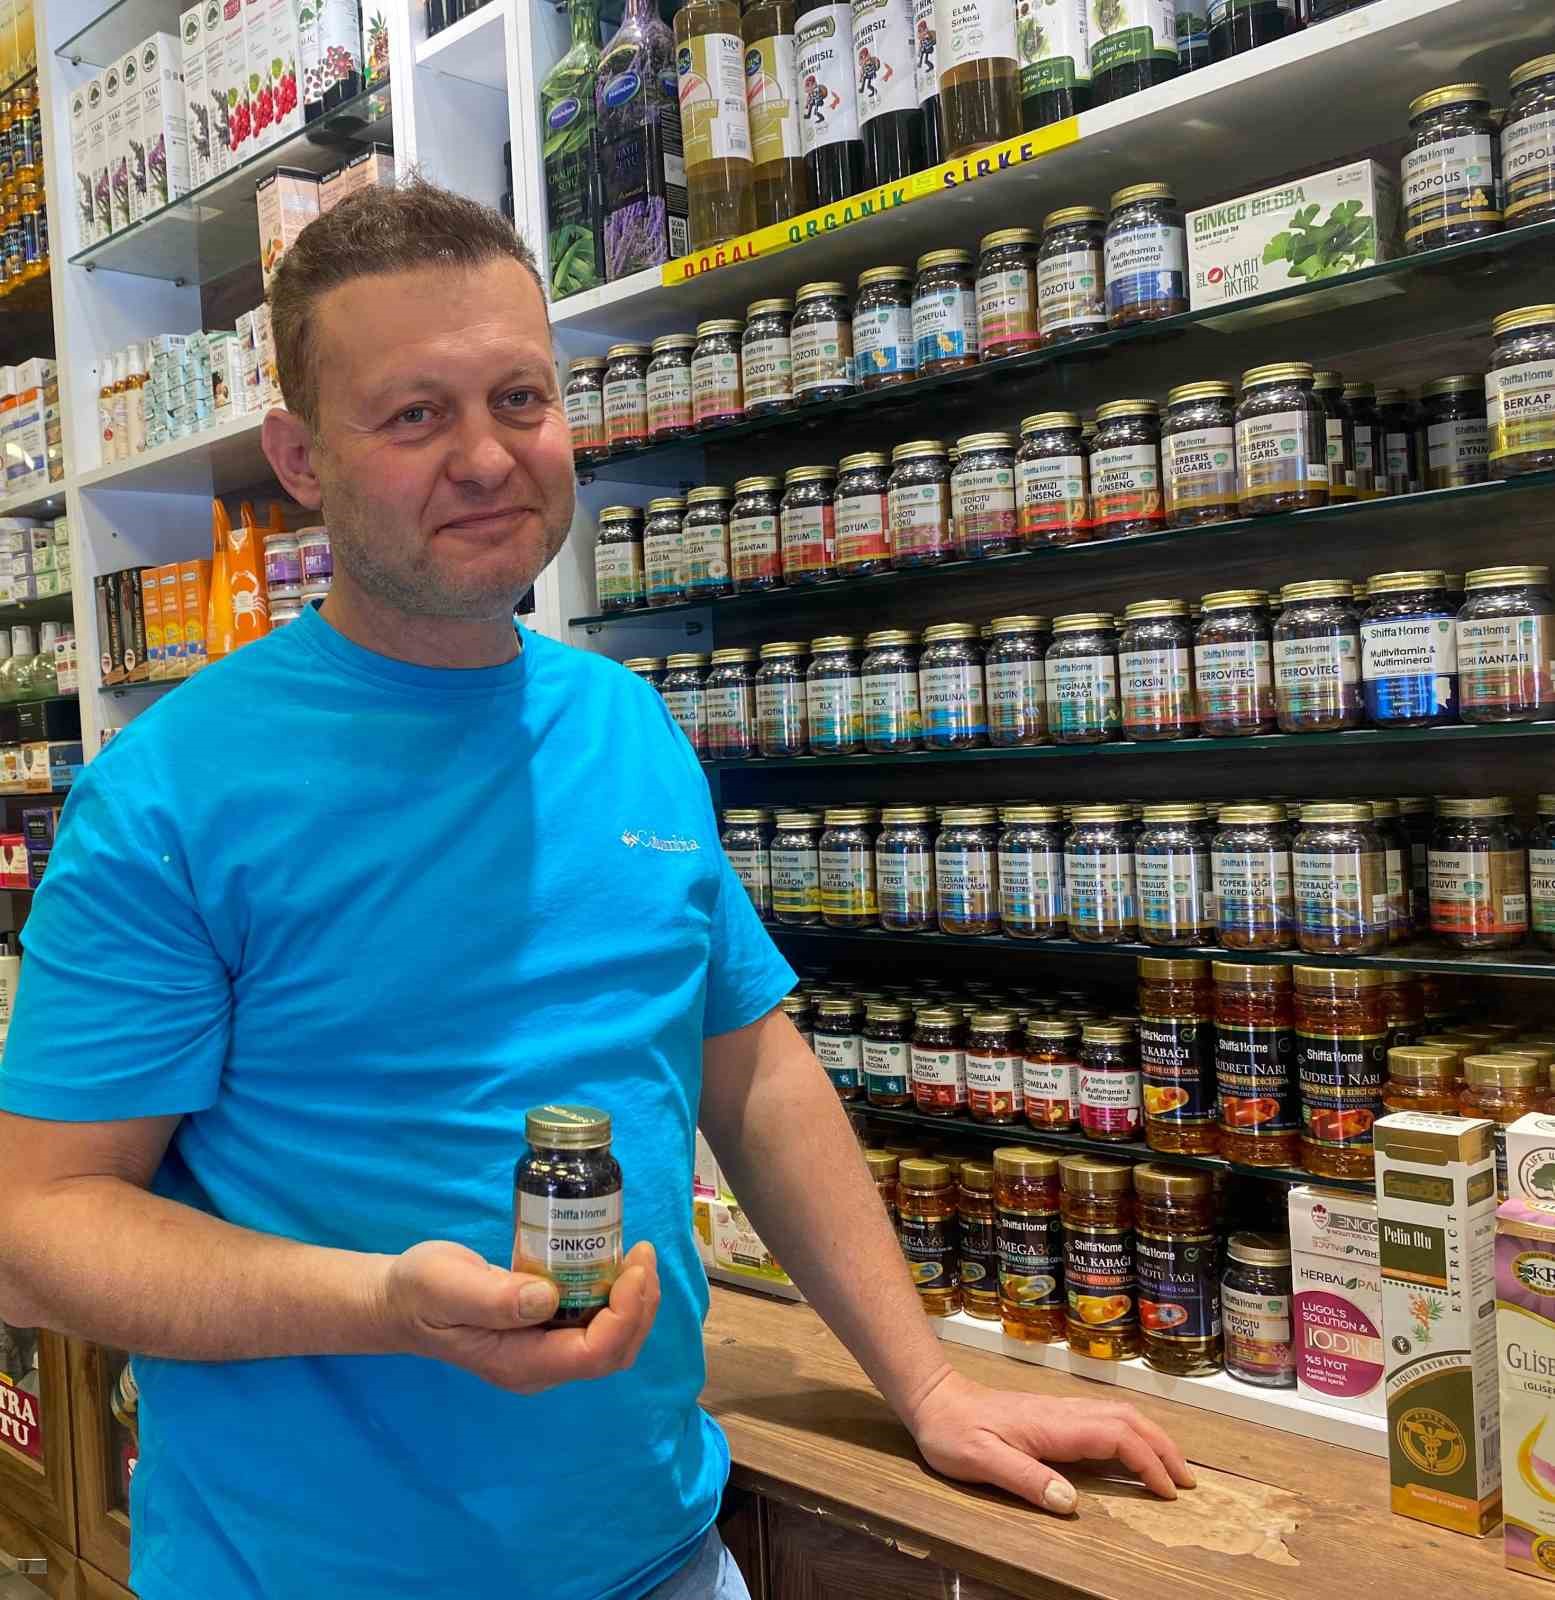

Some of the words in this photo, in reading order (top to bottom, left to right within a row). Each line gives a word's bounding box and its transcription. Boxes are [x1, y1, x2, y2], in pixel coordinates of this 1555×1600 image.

[952, 3, 977, 16] ELMA
[683, 242, 759, 279] DOĞAL
[788, 187, 907, 245] ORGANİK
[943, 142, 1034, 190] SİRKE
[1371, 626, 1398, 638] Shiffa
[1399, 625, 1430, 636] Home
[1370, 645, 1426, 659] Multivitamin
[1373, 655, 1432, 668] Multimineral
[1307, 1049, 1335, 1062] Shiffa
[551, 1207, 579, 1220] Shiffa
[580, 1208, 607, 1219] Home
[549, 1236, 606, 1251] GINKGO
[1384, 1225, 1411, 1247] Pelin
[1413, 1231, 1433, 1250] Otu
[1091, 1255, 1131, 1267] KABAĞI
[1300, 1268, 1345, 1286] HERBAL
[1357, 1279, 1380, 1292] PAL
[1302, 1301, 1347, 1319] LUGOL'S
[1302, 1312, 1358, 1331] SOLUTION
